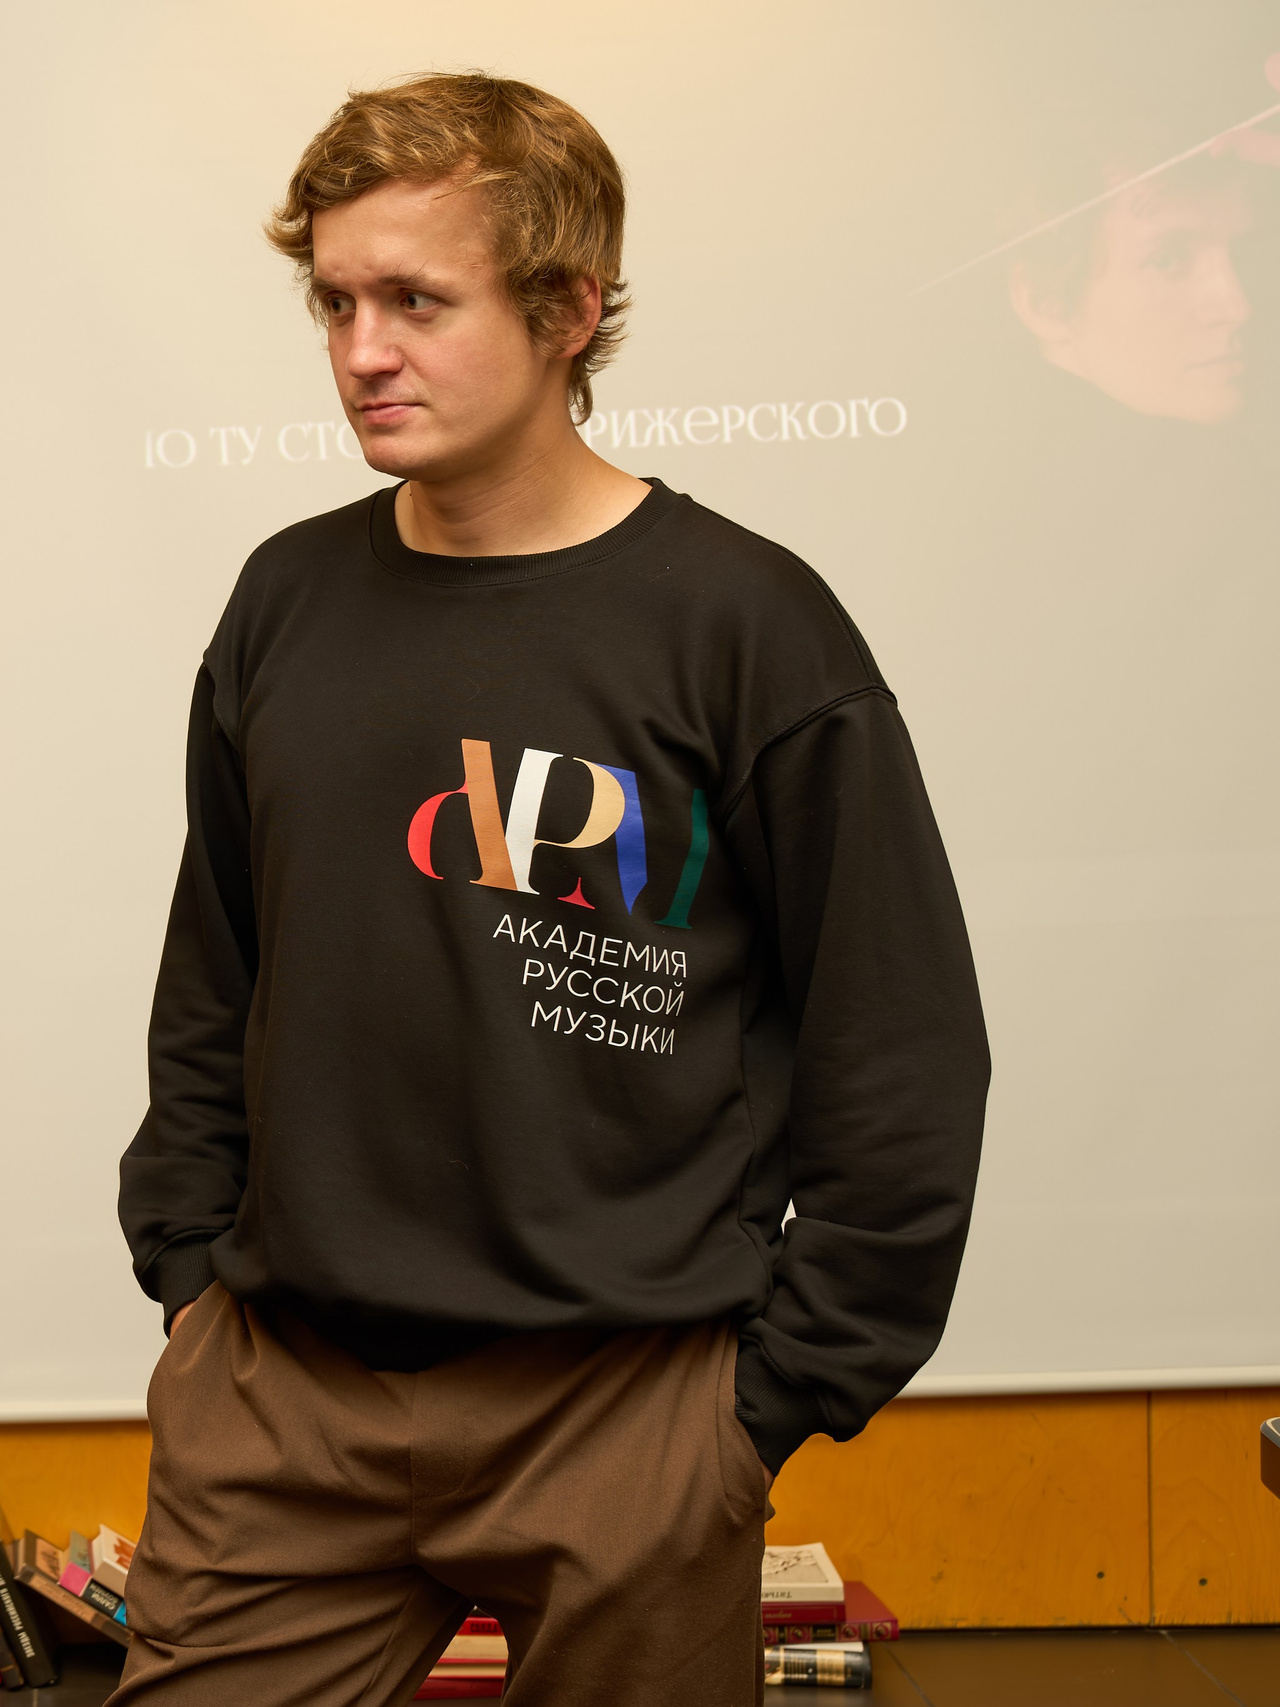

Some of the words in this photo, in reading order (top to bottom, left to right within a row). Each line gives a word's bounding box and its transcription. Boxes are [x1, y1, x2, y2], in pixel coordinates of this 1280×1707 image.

[208, 425, 263, 466] ТУ
[492, 913, 687, 978] АКАДЕМИЯ
[522, 958, 685, 1017] РУССКОЙ
[531, 1000, 676, 1056] МУЗЫКИ
